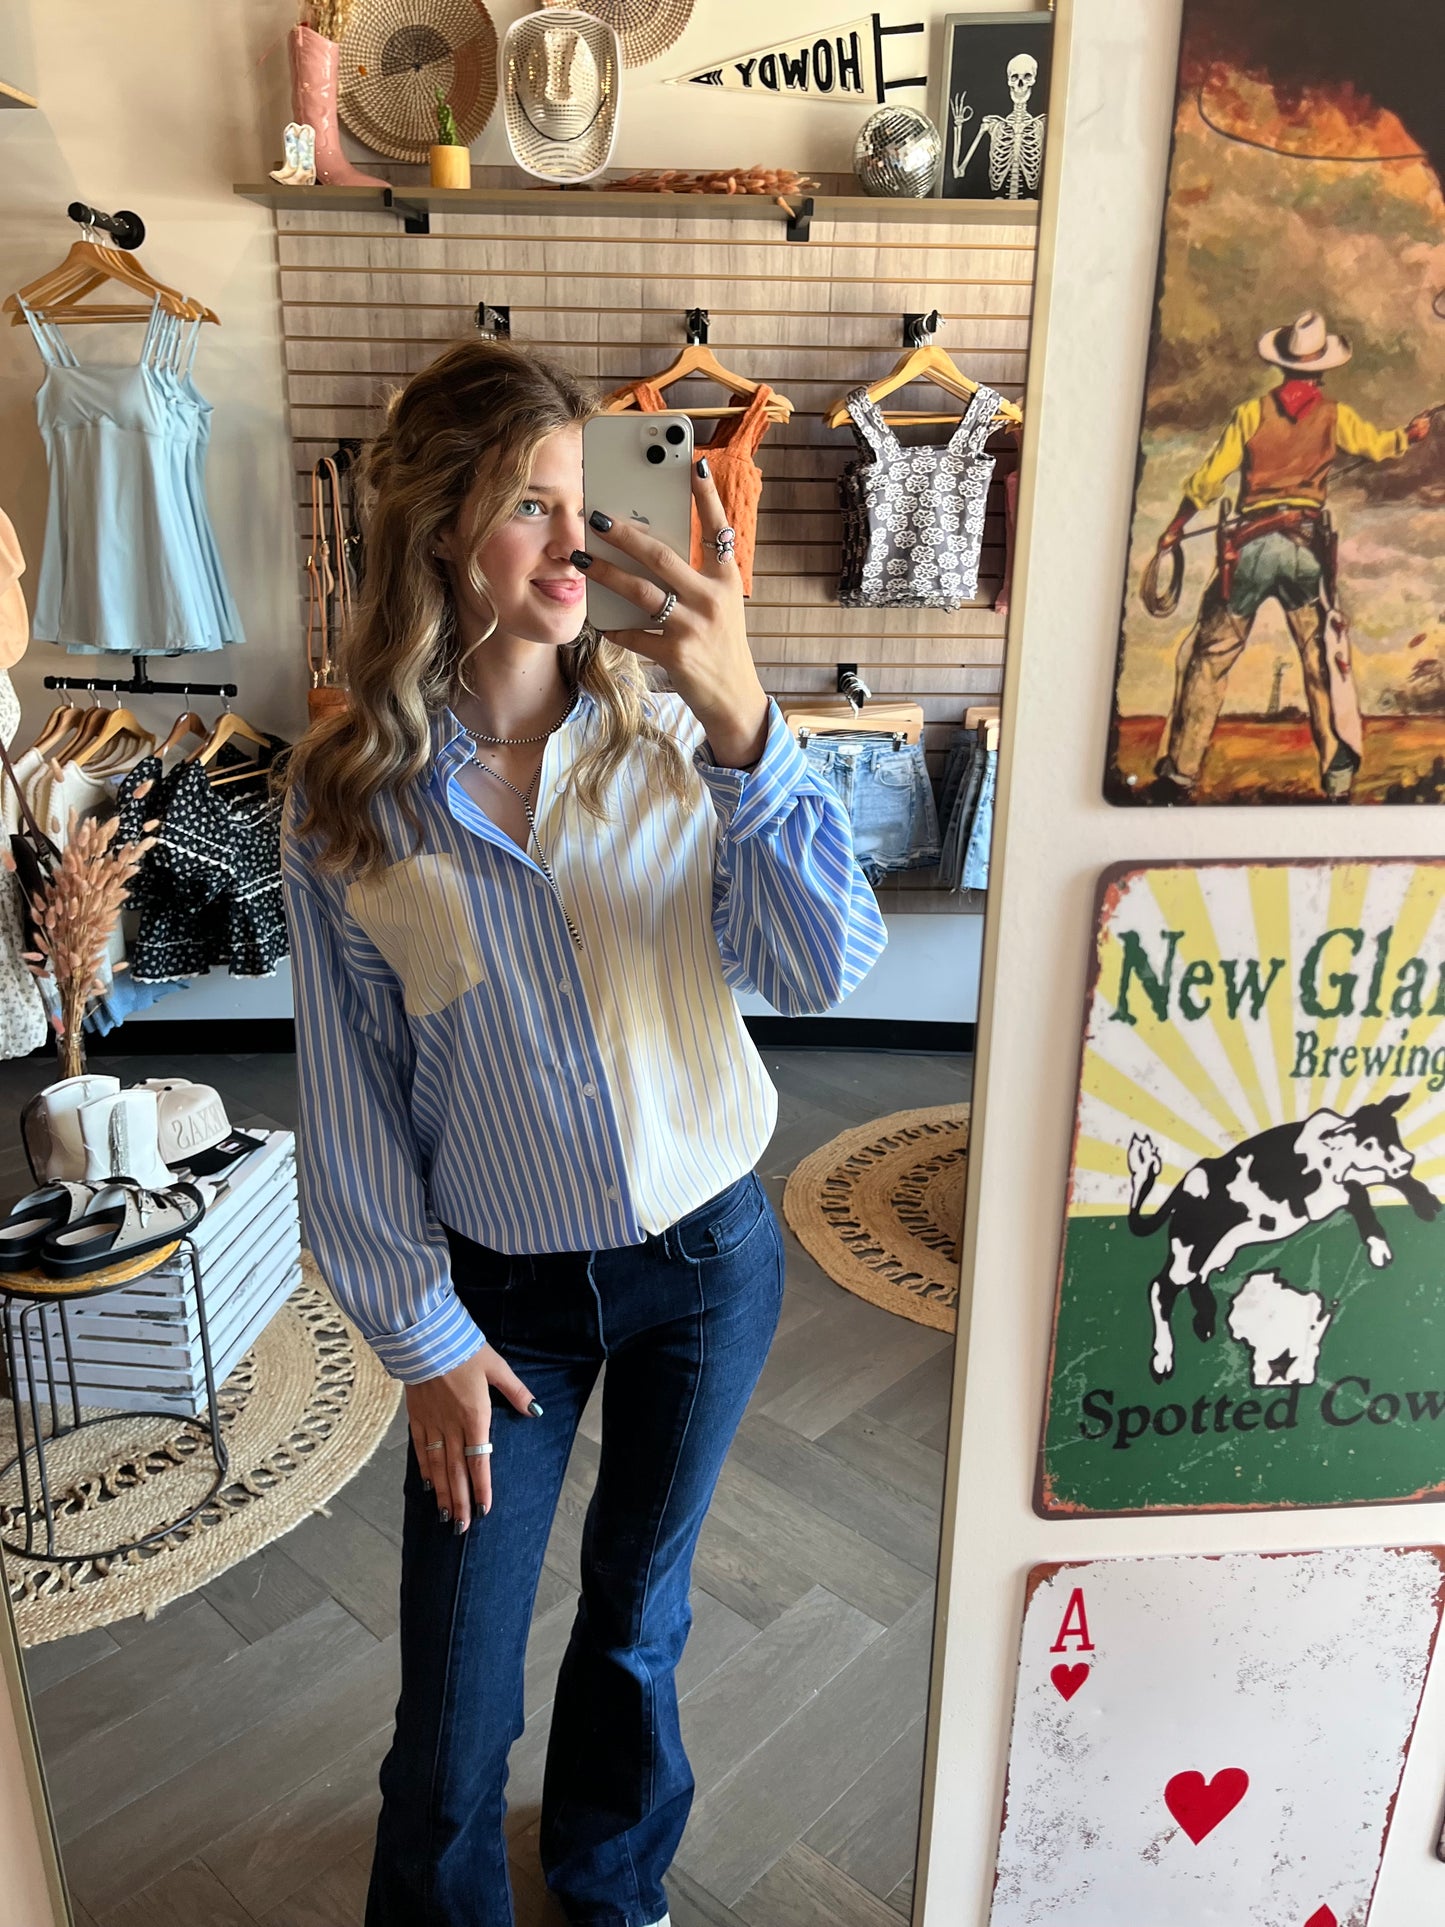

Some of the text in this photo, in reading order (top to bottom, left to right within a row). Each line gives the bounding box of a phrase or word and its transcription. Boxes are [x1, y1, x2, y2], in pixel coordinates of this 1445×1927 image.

[1108, 930, 1286, 1025] New
[1289, 1028, 1445, 1092] Brewing
[1079, 1375, 1445, 1449] Spotted Cow
[1049, 1587, 1095, 1653] A
